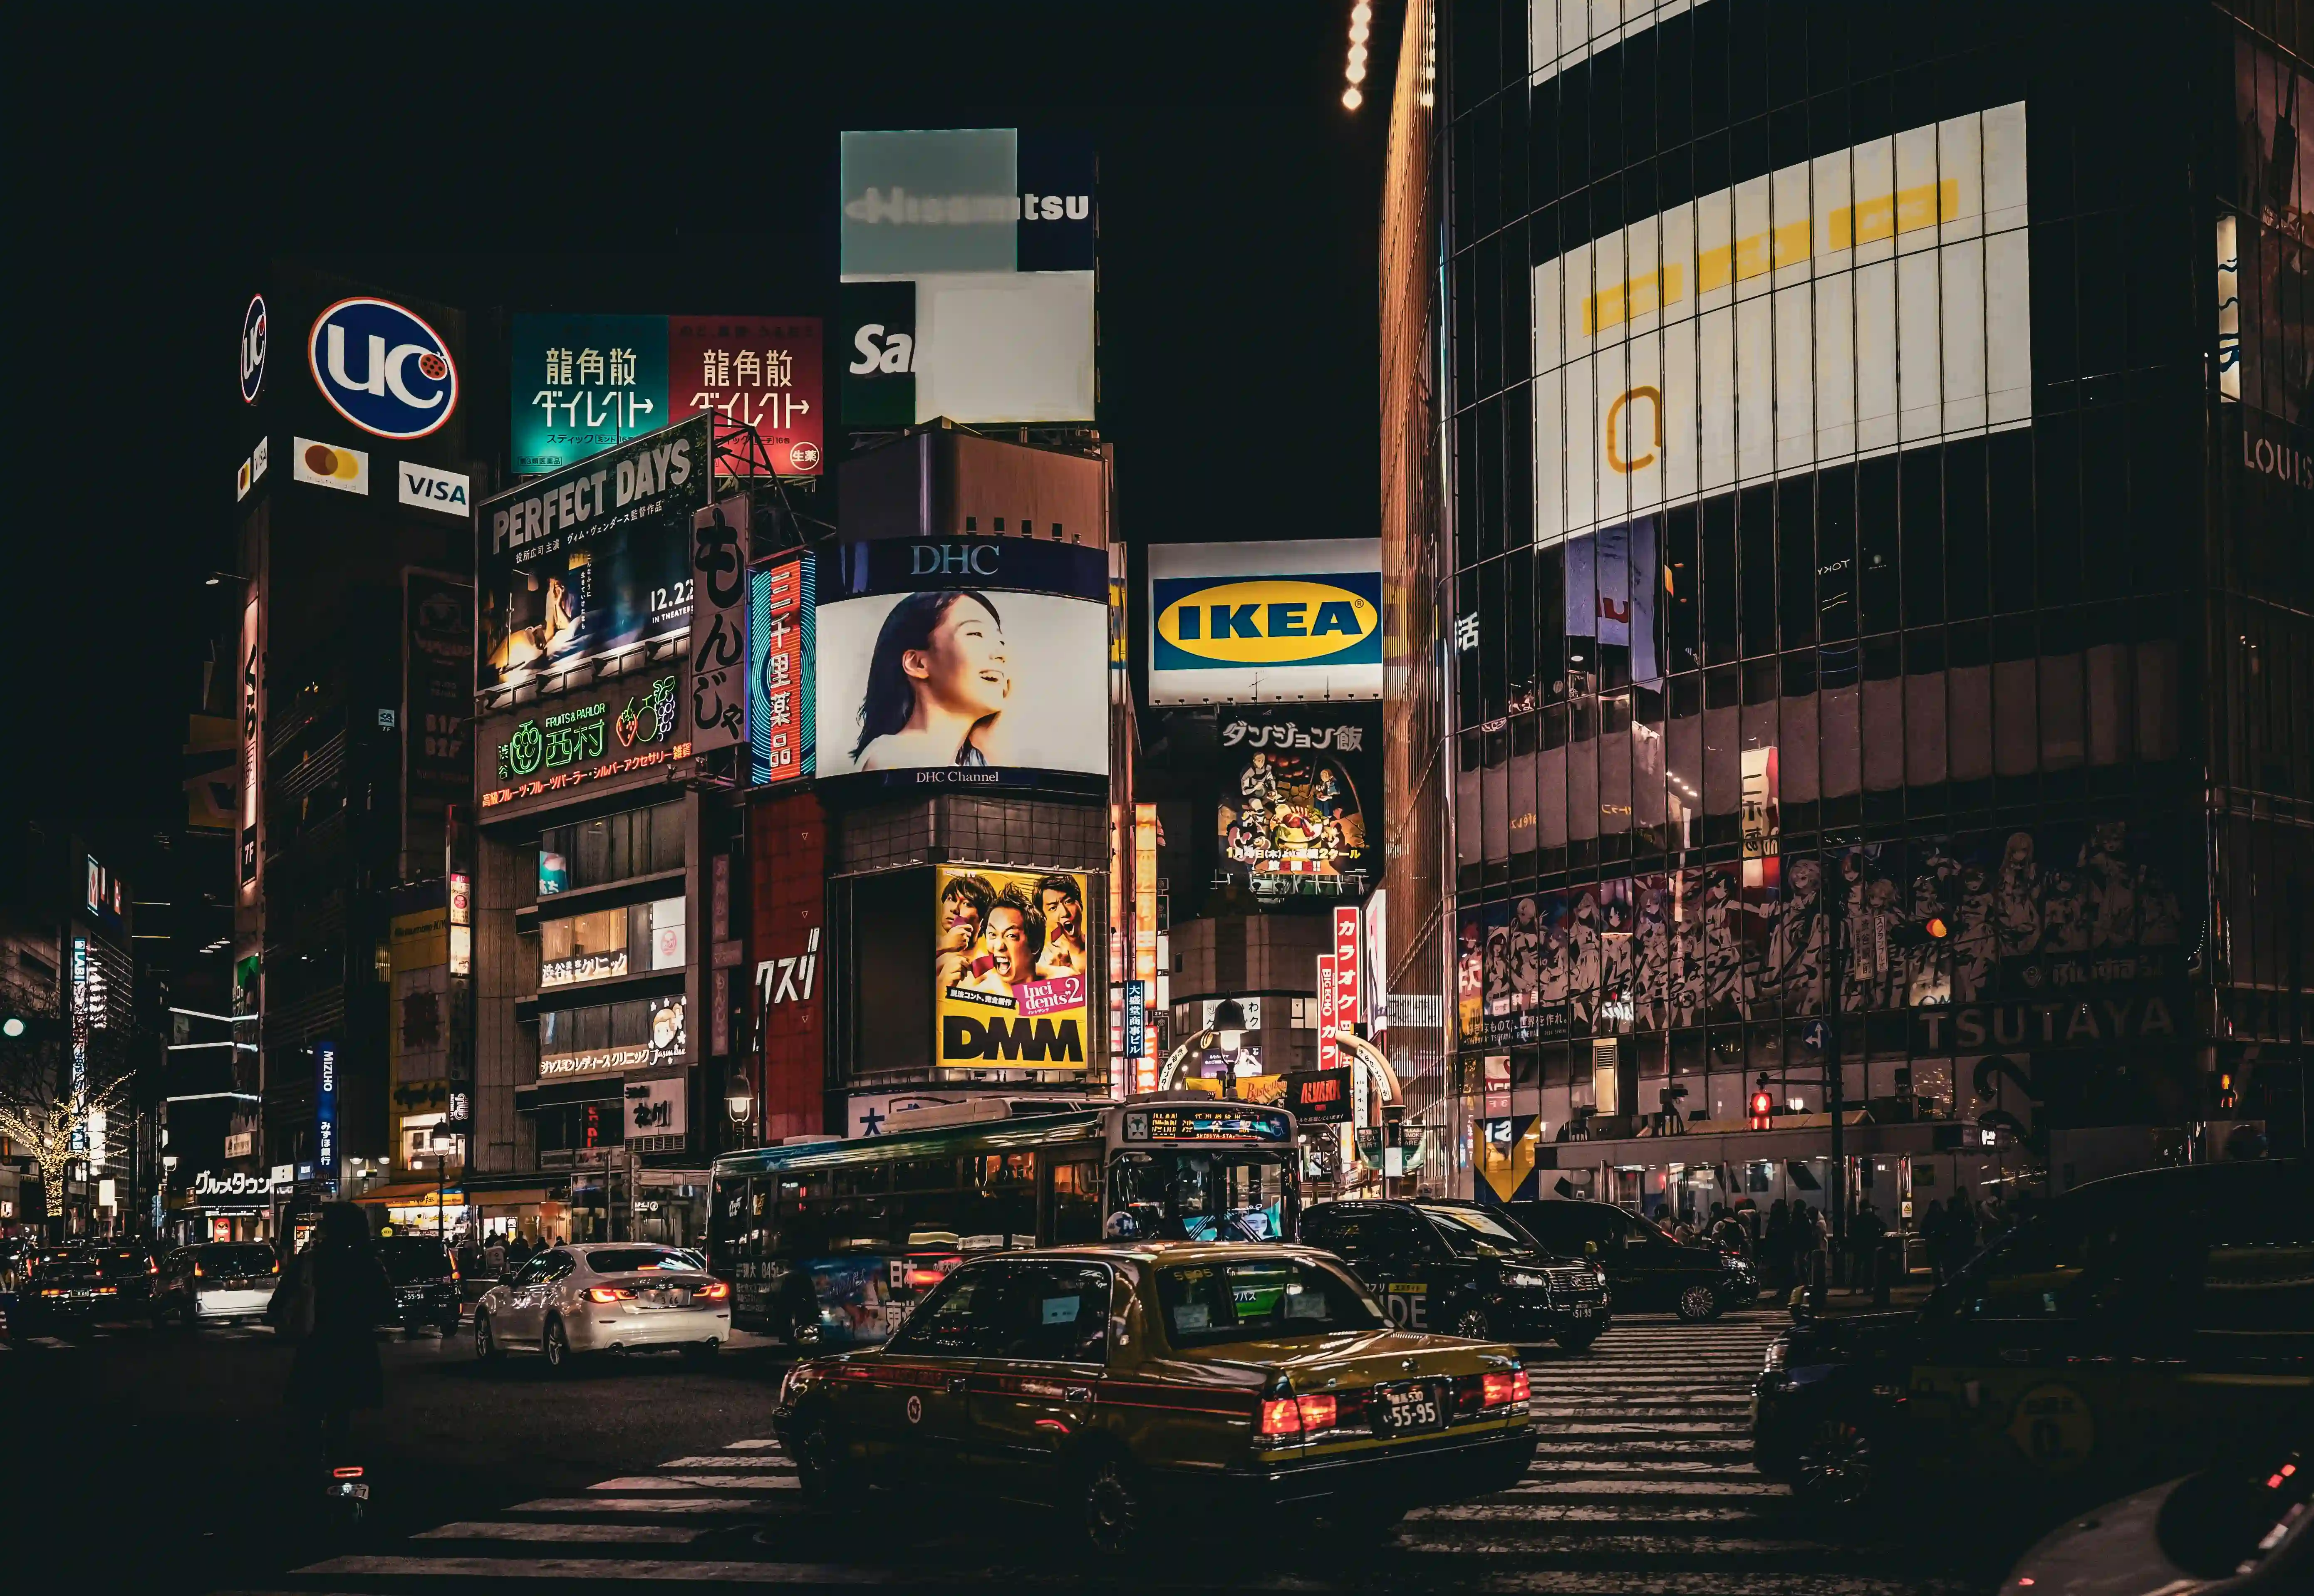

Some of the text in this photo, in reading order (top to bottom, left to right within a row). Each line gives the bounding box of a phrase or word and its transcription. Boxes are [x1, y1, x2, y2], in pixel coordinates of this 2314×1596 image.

[546, 347, 637, 385] 龍角散
[704, 349, 792, 387] 龍角散
[532, 391, 654, 428] ダイレクト
[689, 392, 810, 429] ダイレクト
[546, 435, 593, 444] スティック
[792, 450, 818, 462] 生薬
[404, 473, 466, 505] VISA
[493, 438, 690, 555] PERFECT DAYS
[911, 544, 999, 575] DHC
[651, 579, 693, 611] 12.22
[652, 614, 659, 624] IN
[695, 508, 744, 740] もんじゃ
[1179, 601, 1363, 640] IKEA
[770, 572, 793, 767] 三千里薬品
[546, 719, 605, 767] 西村
[1222, 720, 1363, 752] ダンジョン飯
[916, 771, 999, 782] DHC Channel
[244, 841, 255, 865] 7F
[1338, 920, 1356, 1010] カラオケ
[1322, 968, 1332, 1016] BIG ECHO
[943, 1015, 1084, 1062] DMM
[1129, 985, 1141, 1055] 大盛堂商事ビル
[1918, 996, 2174, 1049] TSUTAYA
[323, 1051, 333, 1092] MIZUHO
[321, 1122, 332, 1165] みずほ銀行
[196, 1170, 271, 1194] グルメタウン
[1392, 1402, 1436, 1427] 55-95
